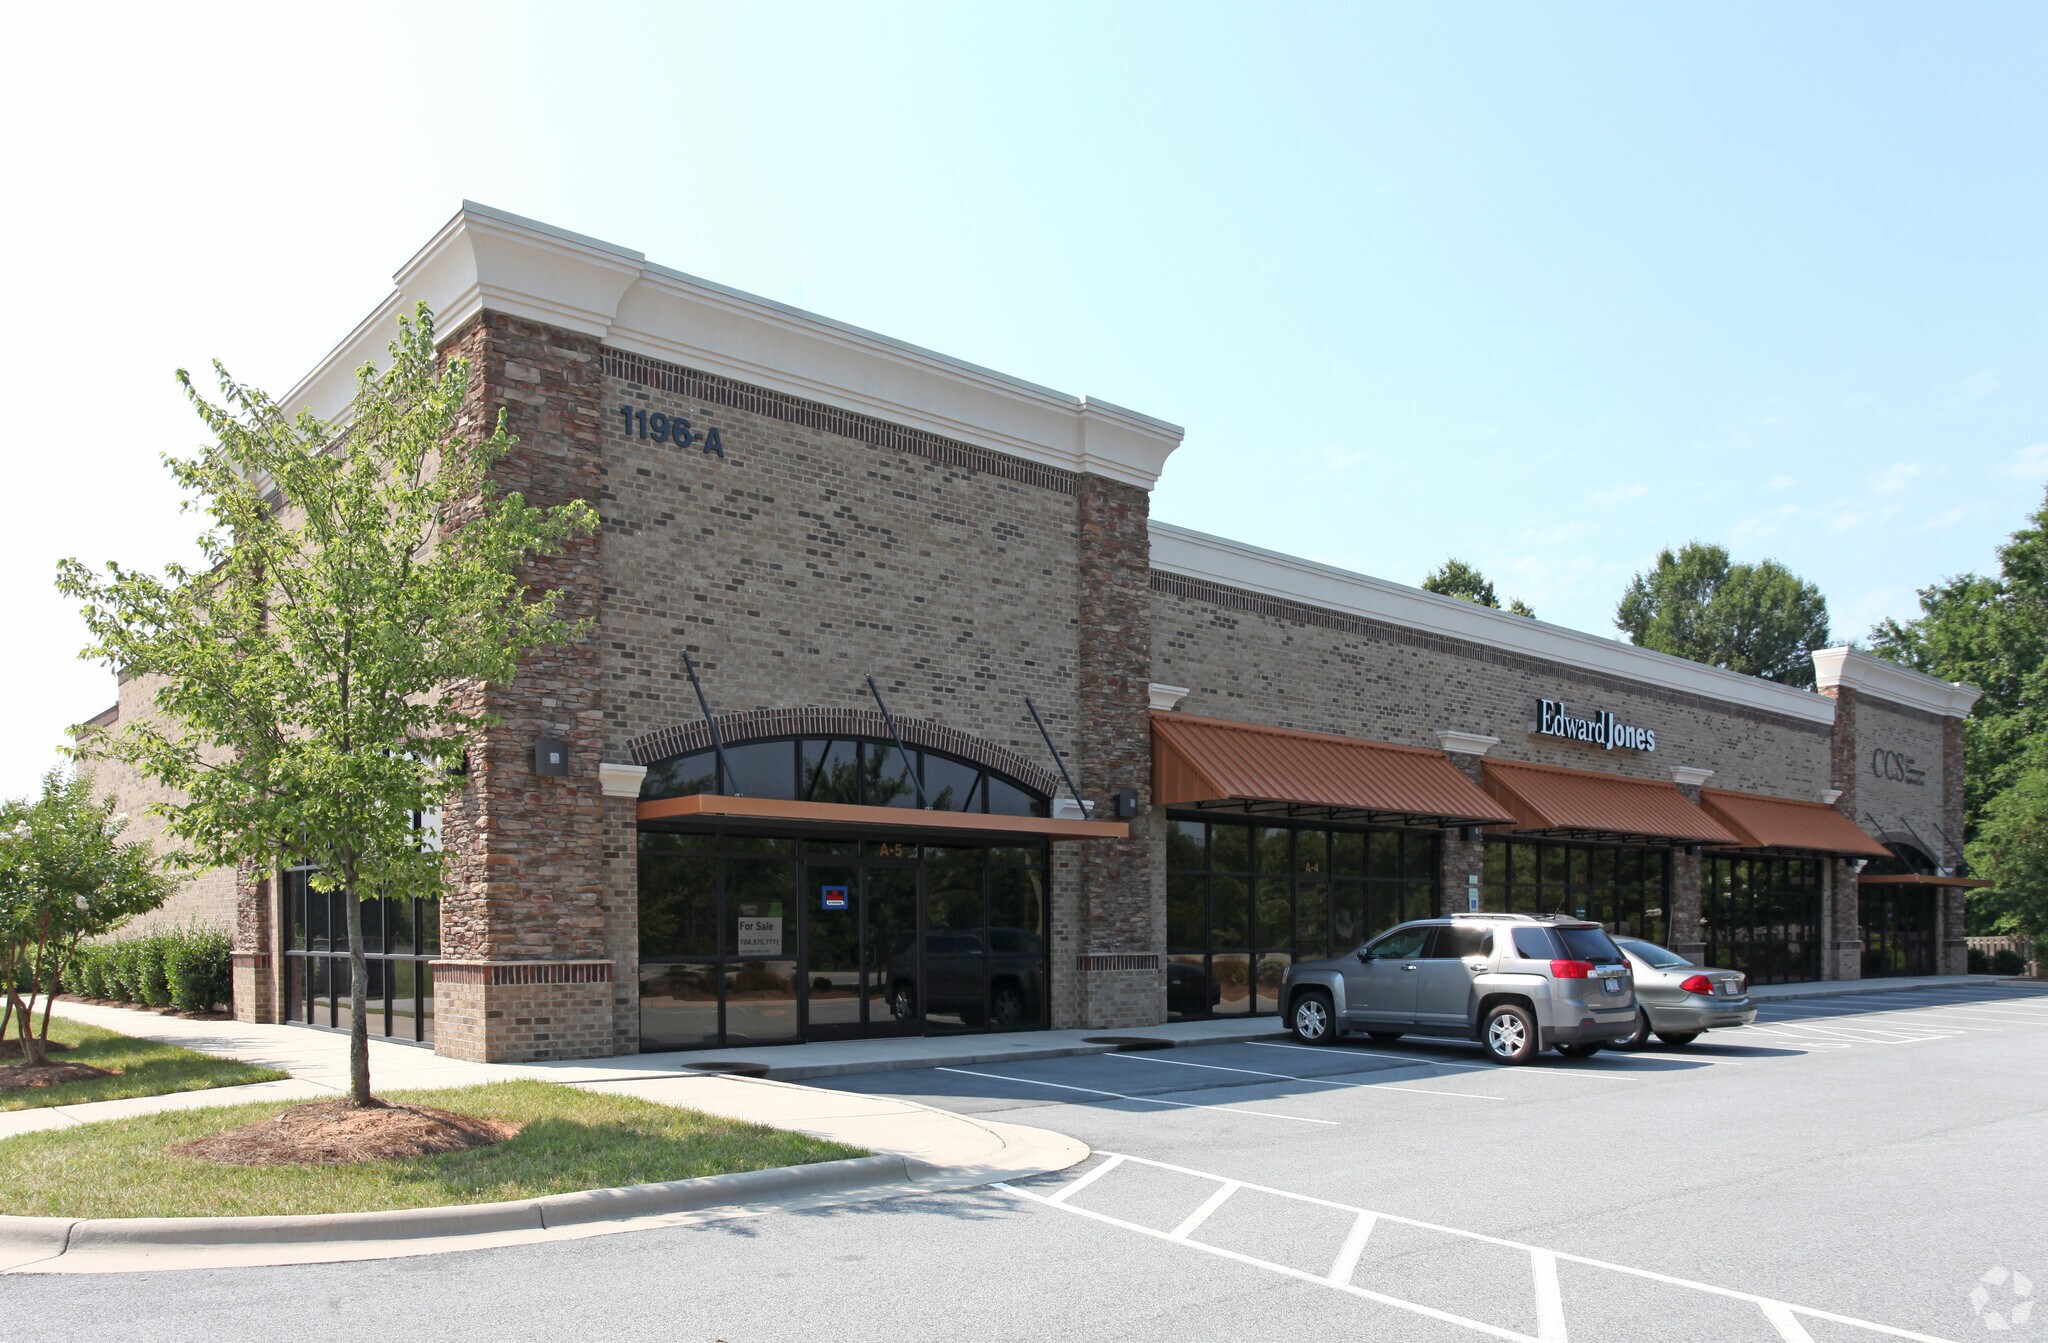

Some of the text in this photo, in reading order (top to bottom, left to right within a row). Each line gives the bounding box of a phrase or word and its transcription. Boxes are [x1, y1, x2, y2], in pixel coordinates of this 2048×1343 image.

[621, 405, 724, 458] 1196-A
[1537, 698, 1656, 752] Edward Jones
[879, 842, 902, 857] A-5
[1305, 862, 1319, 872] A-4
[739, 921, 774, 931] For Sale
